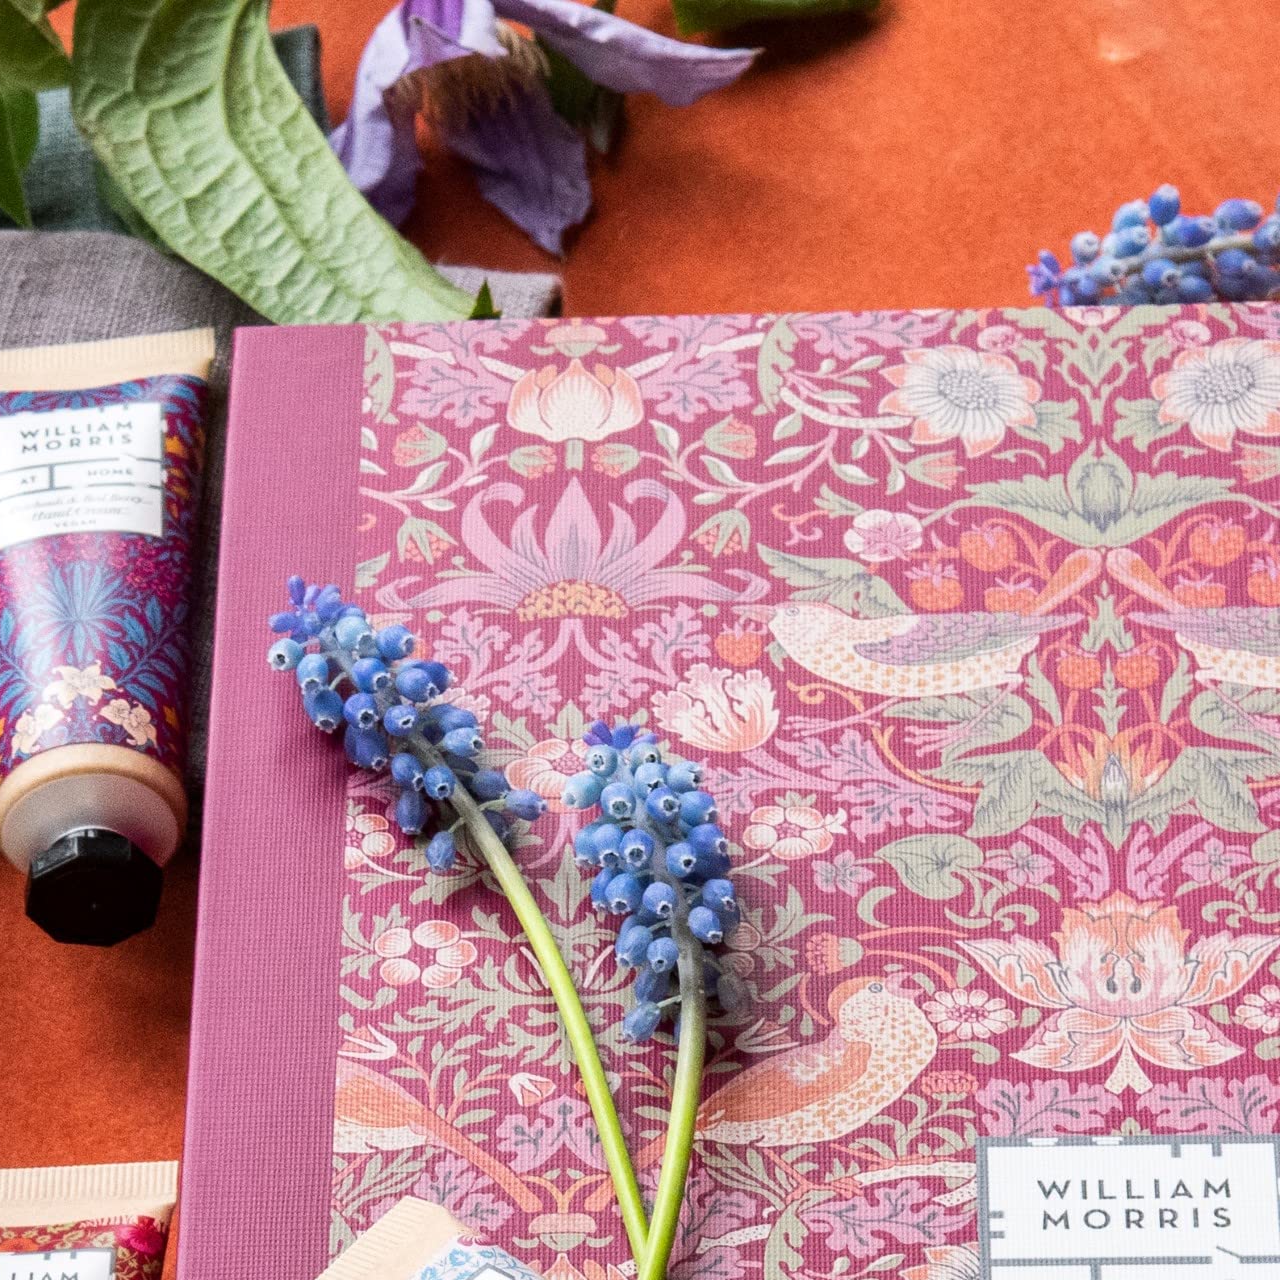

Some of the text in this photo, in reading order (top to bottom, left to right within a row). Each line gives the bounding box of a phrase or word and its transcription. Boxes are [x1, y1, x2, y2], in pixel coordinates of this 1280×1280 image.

[20, 422, 133, 439] WILLIAM
[22, 435, 132, 453] MORRIS
[20, 468, 133, 485] AT HOME
[1037, 1178, 1232, 1200] WILLIAM
[1042, 1207, 1232, 1230] MORRIS
